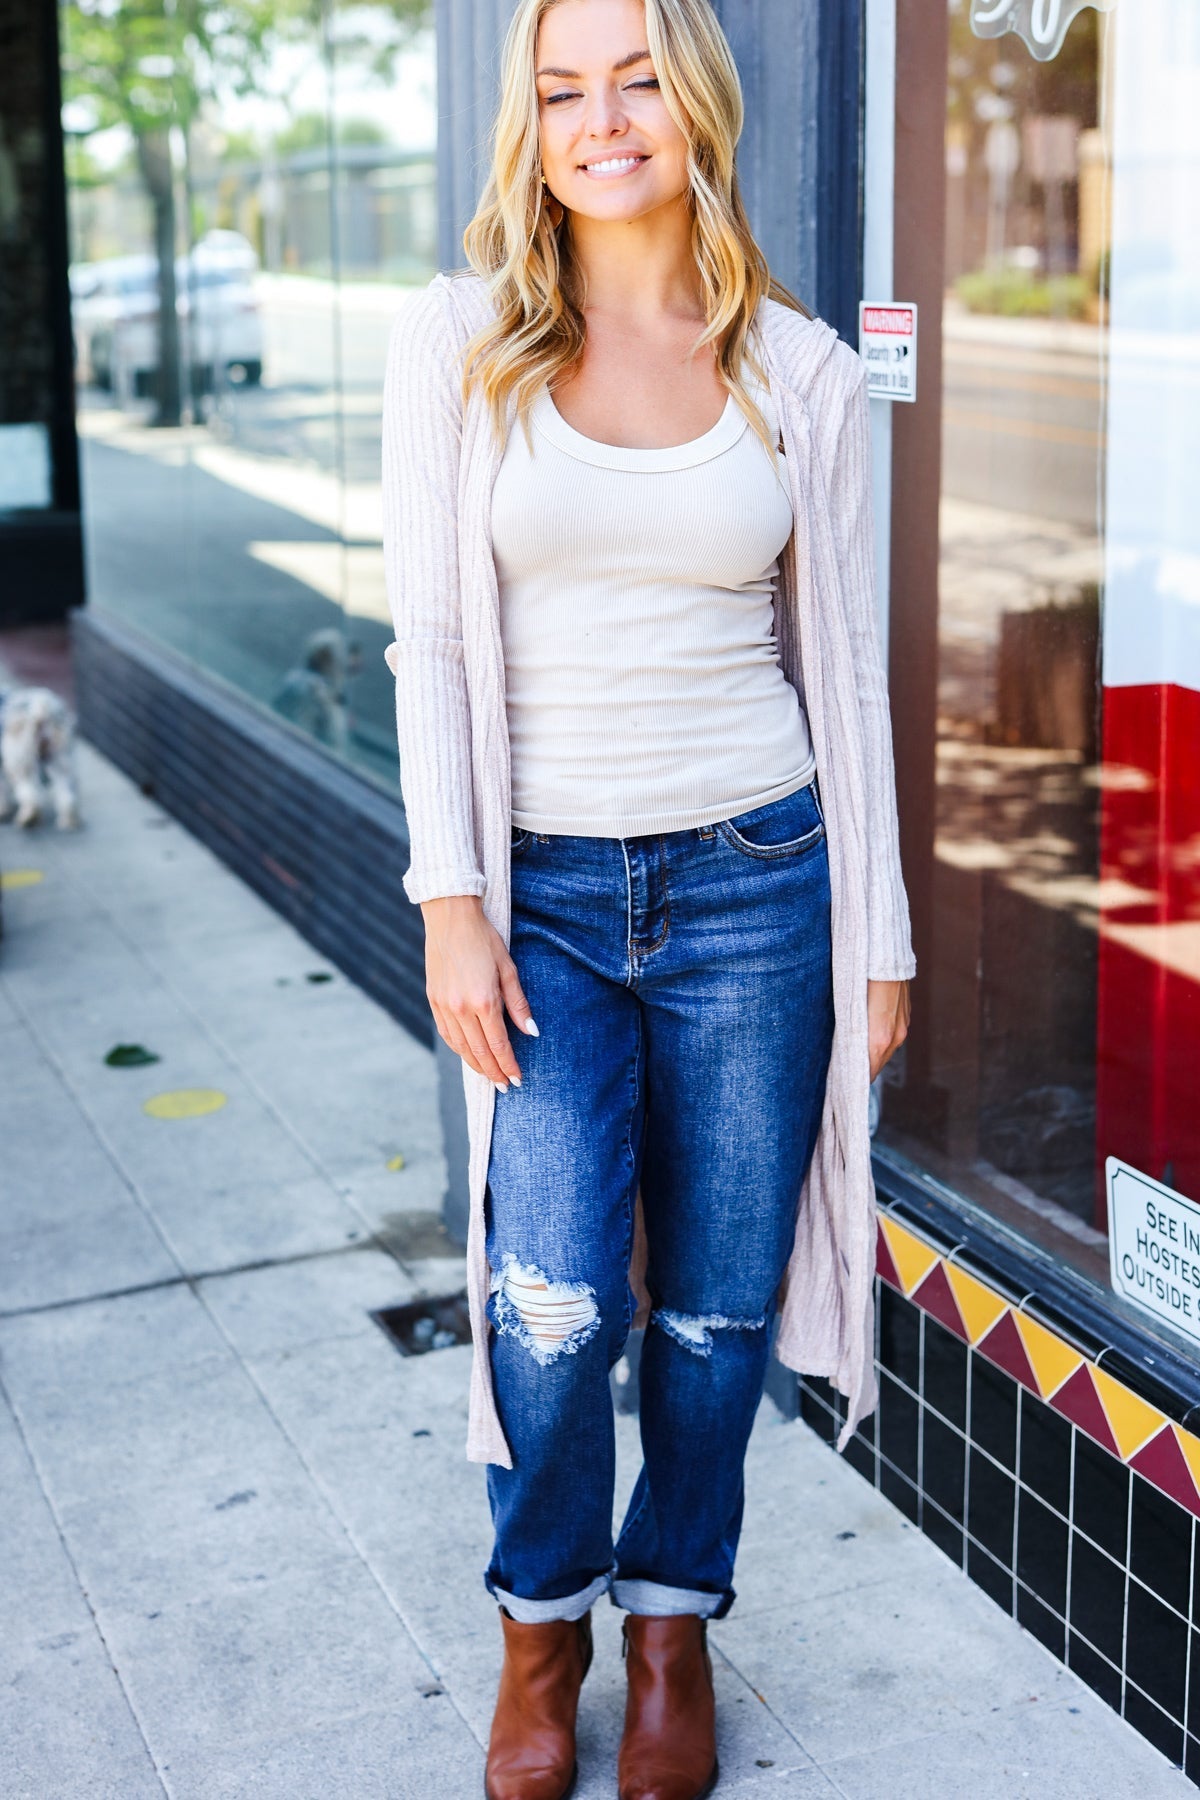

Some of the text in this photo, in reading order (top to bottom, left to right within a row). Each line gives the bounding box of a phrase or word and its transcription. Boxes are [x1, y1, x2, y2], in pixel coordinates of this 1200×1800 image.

[866, 310, 912, 333] WARNING
[1146, 1201, 1178, 1242] SEE
[1122, 1252, 1192, 1318] OUTSIDE
